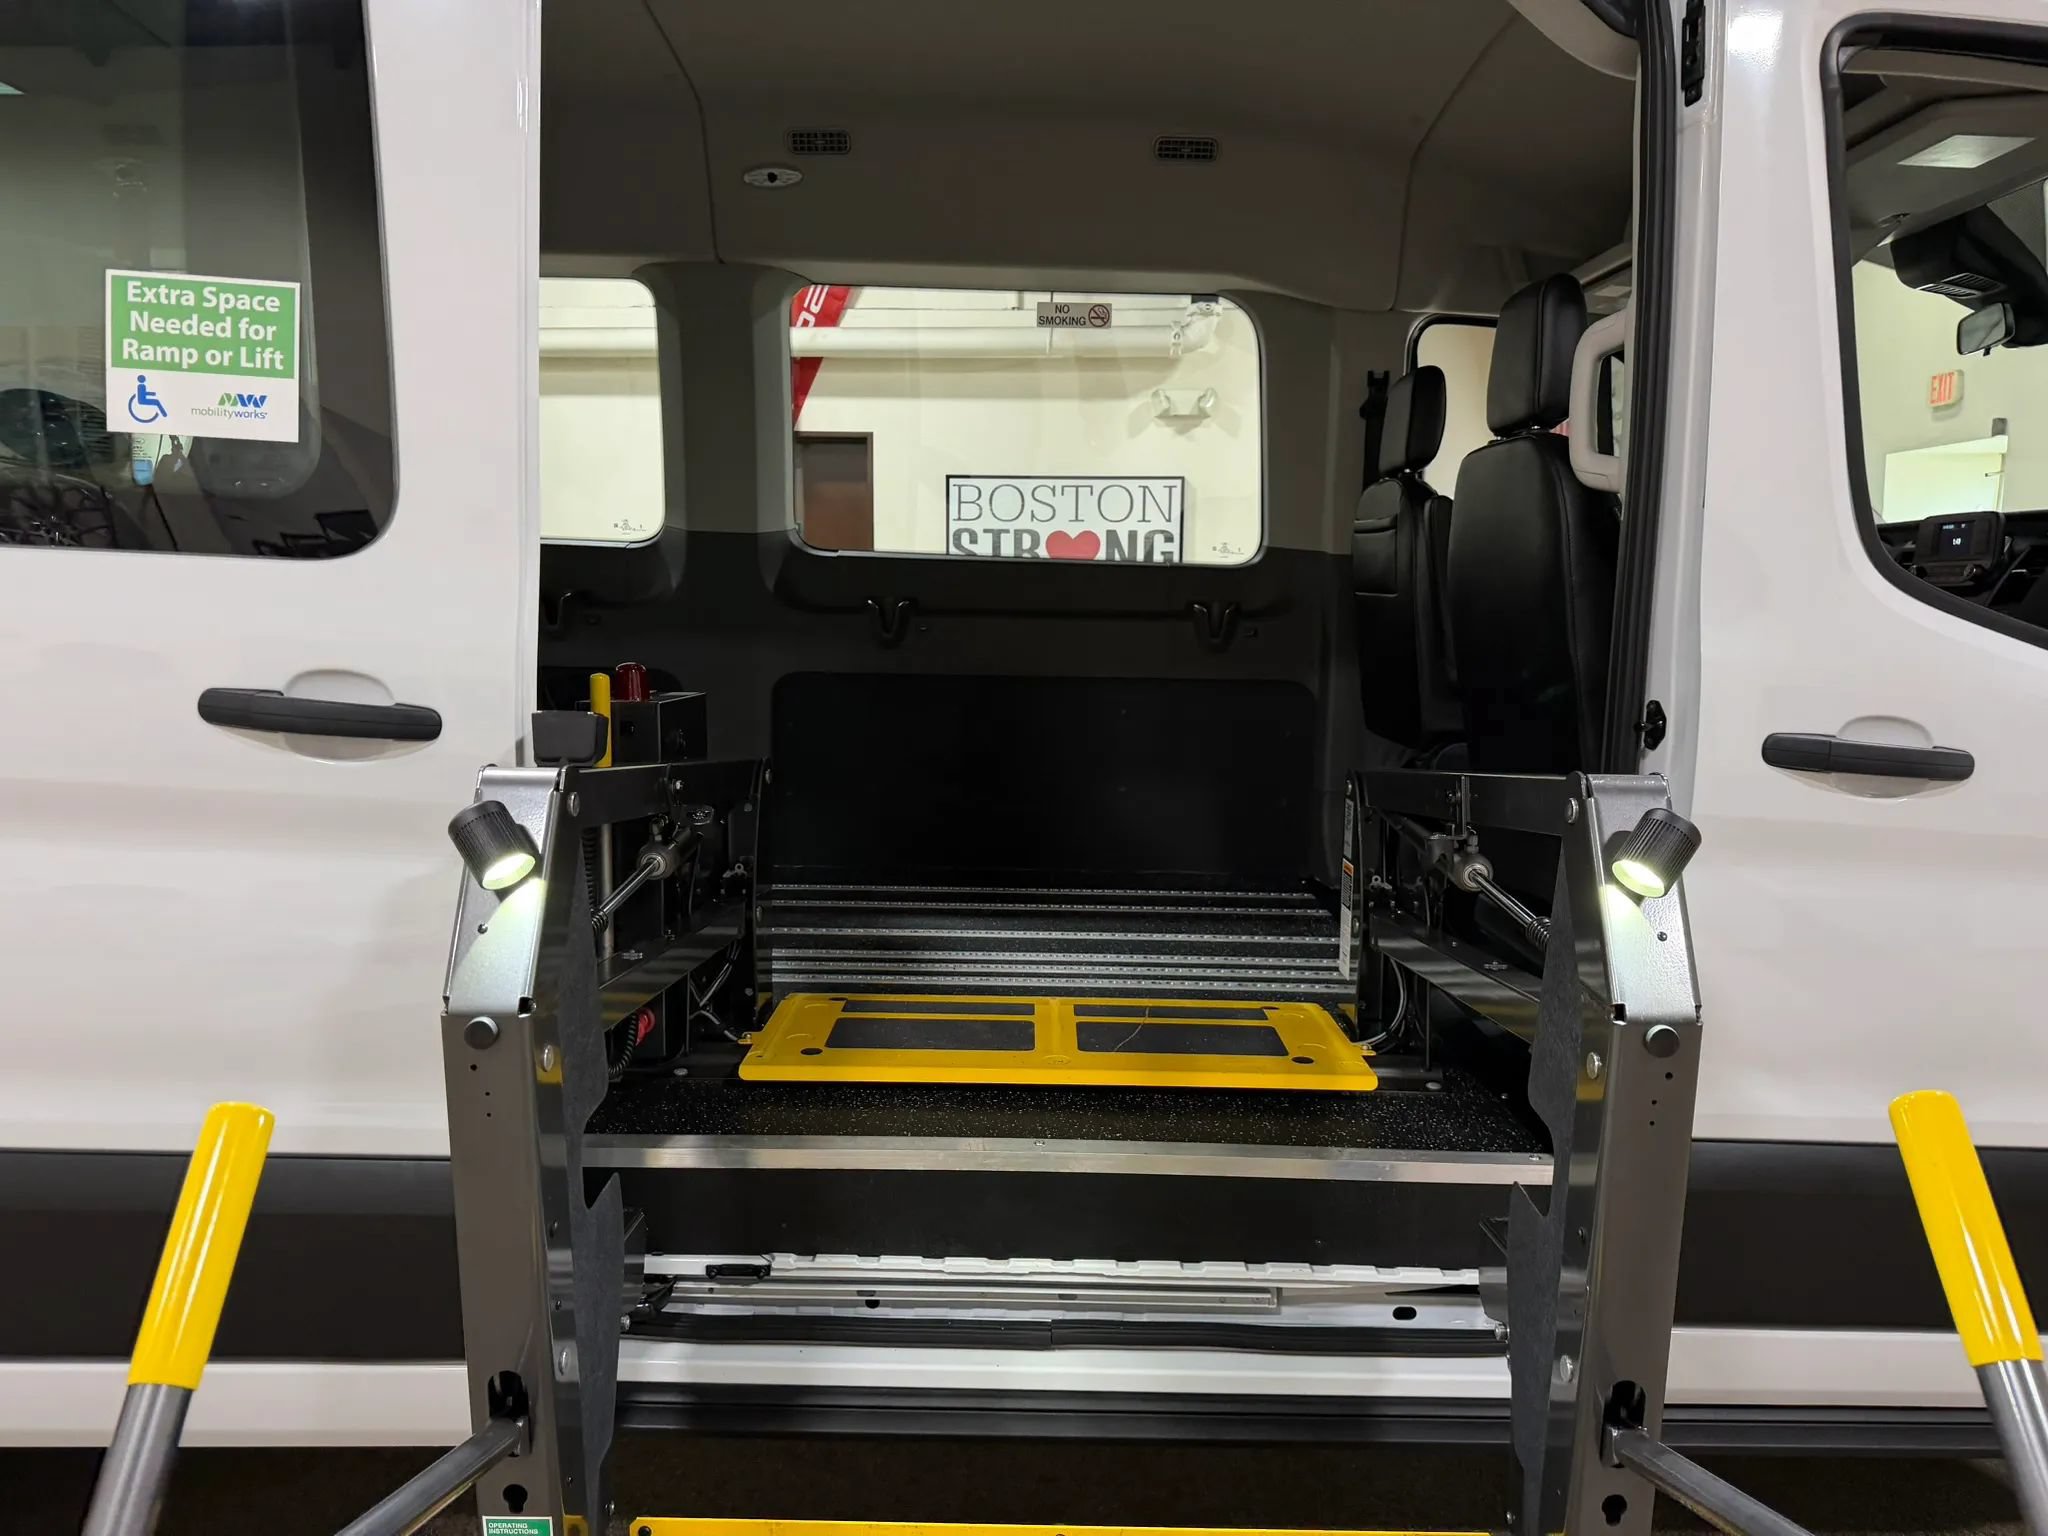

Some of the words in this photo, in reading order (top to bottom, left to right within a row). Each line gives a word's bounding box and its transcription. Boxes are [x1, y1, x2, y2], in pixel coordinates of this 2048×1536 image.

[127, 280, 195, 306] Extra
[202, 286, 281, 314] Space
[1055, 304, 1070, 314] NO
[130, 310, 232, 338] Needed
[238, 317, 277, 341] for
[1038, 315, 1087, 326] SMOKING
[122, 338, 199, 369] Ramp
[205, 348, 233, 367] or
[240, 346, 284, 370] Lift
[1929, 371, 1955, 404] EXIT
[191, 406, 268, 420] mobilityworks
[952, 483, 1178, 523] BOSTON
